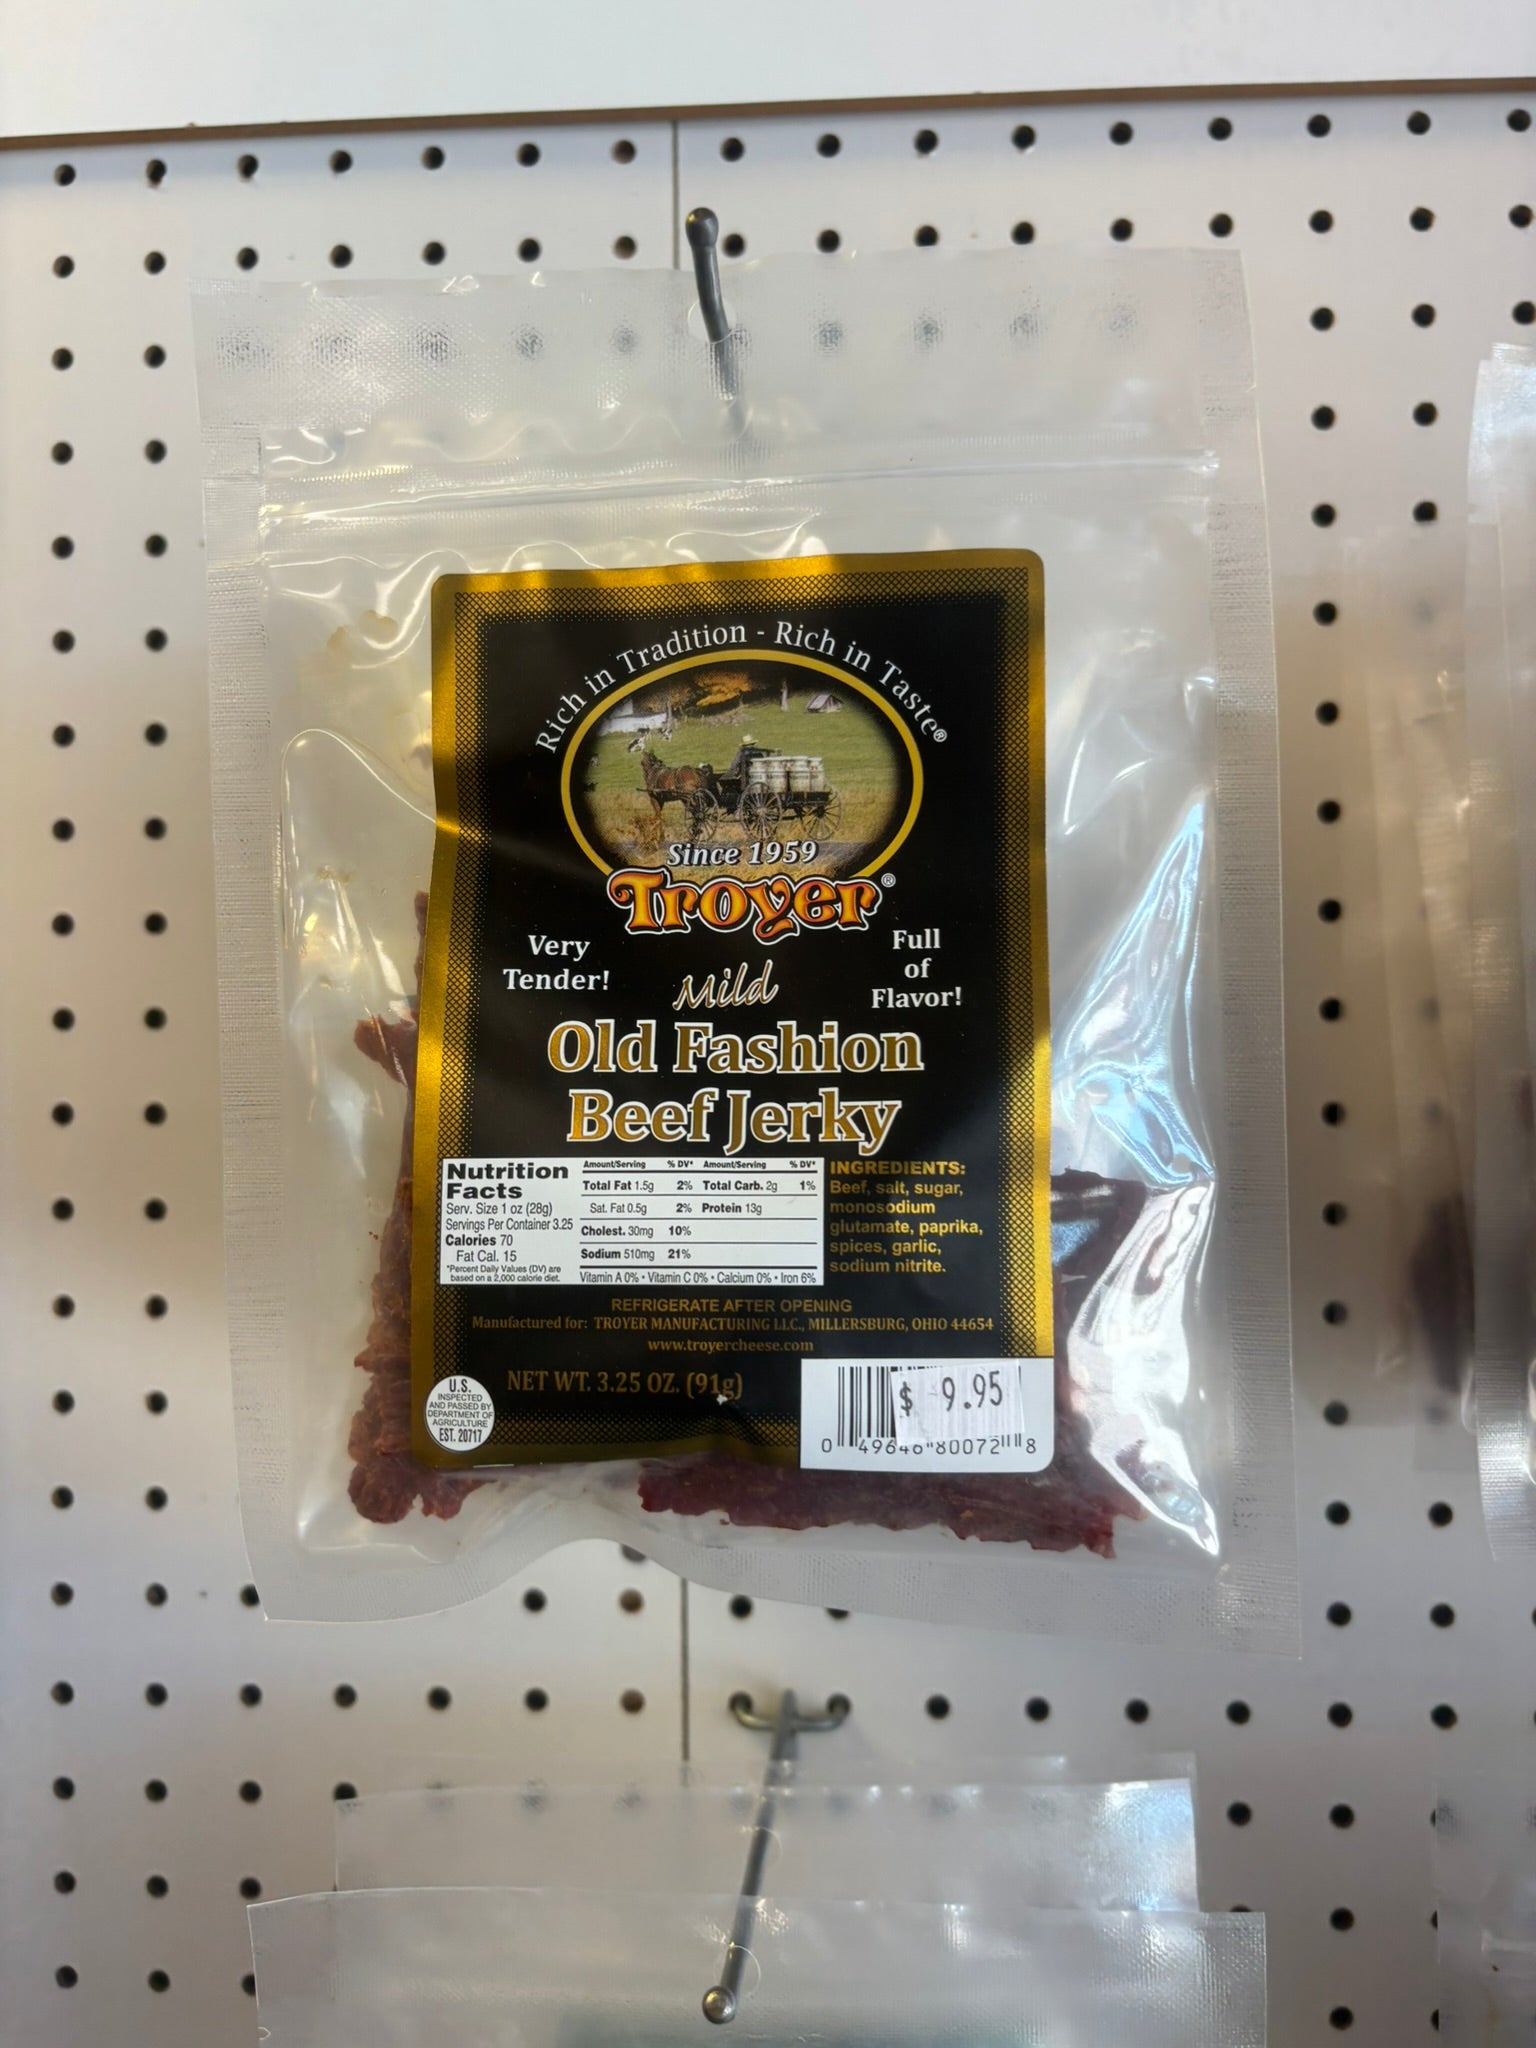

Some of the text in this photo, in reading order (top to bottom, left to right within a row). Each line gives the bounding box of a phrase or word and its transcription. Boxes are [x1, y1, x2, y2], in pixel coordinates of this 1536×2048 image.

[535, 694, 587, 754] Rich
[584, 668, 616, 696] in
[616, 624, 747, 674] Tradition
[774, 621, 836, 657] Rich
[843, 640, 871, 673] in
[667, 840, 818, 867] Since 1959
[892, 929, 941, 949] Full
[528, 934, 591, 961] Very
[904, 958, 931, 978] of
[503, 968, 610, 991] Tender!
[672, 959, 779, 1011] Mild
[871, 986, 962, 1008] Flavor!
[547, 1018, 925, 1074] Old Fashion
[566, 1087, 902, 1156] Beef Jerky
[447, 1162, 569, 1180] Nutrition
[583, 1161, 646, 1170] Amount/Serving
[703, 1161, 766, 1170] Amount/Serving
[830, 1161, 966, 1175] INGREDIENTS:
[447, 1183, 523, 1199] Facts
[583, 1180, 654, 1192] Total Fat 1.5g
[677, 1181, 693, 1190] 2%
[703, 1181, 778, 1193] Total Carb. 2g
[800, 1181, 816, 1190] 1%
[830, 1180, 963, 1197] Beef, salt, sugar,
[446, 1202, 553, 1217] Serv. Size 1 oz (28g)
[590, 1203, 647, 1215] Sat. Fat 0.5g
[676, 1203, 692, 1213] 2%
[702, 1203, 762, 1215] Protein 13g
[830, 1200, 936, 1213] monosodium
[446, 1218, 573, 1232] Servings Per Container 3.25
[669, 1226, 691, 1236] 10%
[830, 1219, 983, 1236] glutamate, paprika,
[581, 1226, 654, 1239] Cholest. 30mg
[445, 1234, 513, 1246] Calories 70
[668, 1249, 691, 1259] 21%
[830, 1239, 942, 1256] spices, garlic,
[456, 1250, 517, 1262] Fat Cal. 15
[581, 1249, 655, 1261] Sodium 510mg
[481, 1265, 499, 1273] Daily
[529, 1265, 546, 1274] (DV)
[830, 1259, 946, 1273] sodium nitrite.
[494, 1274, 515, 1282] 2,000
[580, 1272, 817, 1284] Vitamin A 0% Vitamin C 0% Calcium 0% Iron 6%
[611, 1299, 852, 1313] REFRIGERATE AFTER OPENING
[472, 1315, 562, 1329] Manufactured
[565, 1315, 588, 1329] for:
[594, 1317, 648, 1330] TROYER
[652, 1317, 770, 1331] MANUFACTURING
[808, 1318, 909, 1332] MILLERSBURG,
[912, 1318, 947, 1331] OHIO
[951, 1318, 994, 1331] 44654
[648, 1339, 814, 1354] www.troyercheese.com
[449, 1378, 471, 1392] U.S.
[507, 1370, 743, 1400] NET WT. 3.25 OZ. (91g)
[438, 1393, 482, 1401] INSPECTED
[900, 1370, 1003, 1416] $ 9.95
[448, 1402, 479, 1410] PASSED
[428, 1410, 479, 1418] DEPARTMENT
[433, 1419, 488, 1427] AGRICULTURE
[439, 1428, 482, 1442] EST. 20717
[821, 1438, 832, 1454] 0
[1025, 1439, 1036, 1453] 8
